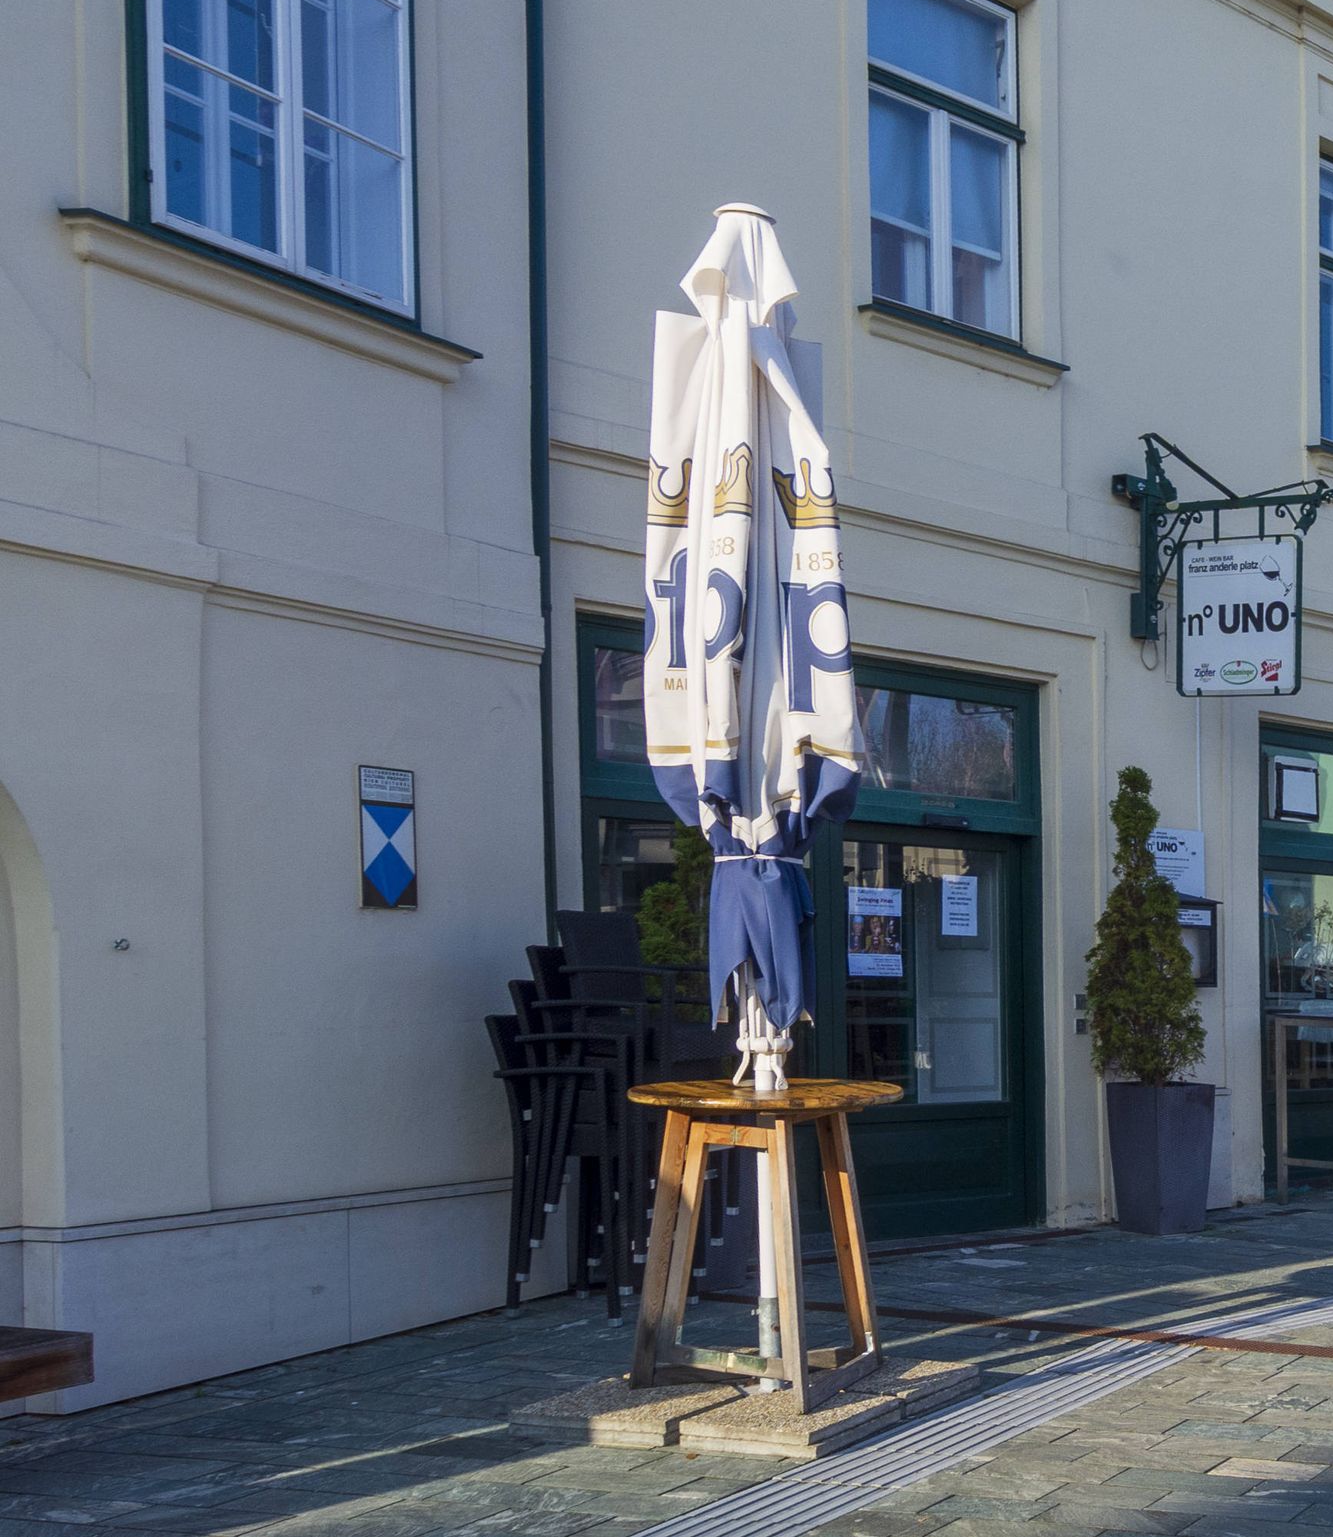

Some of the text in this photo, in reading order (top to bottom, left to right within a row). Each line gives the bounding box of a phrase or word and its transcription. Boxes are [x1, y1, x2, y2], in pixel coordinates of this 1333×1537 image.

[1188, 561, 1259, 573] franz anderle platz
[1218, 601, 1290, 634] UNO
[1194, 668, 1216, 678] Zipfer
[1156, 841, 1178, 853] UNO
